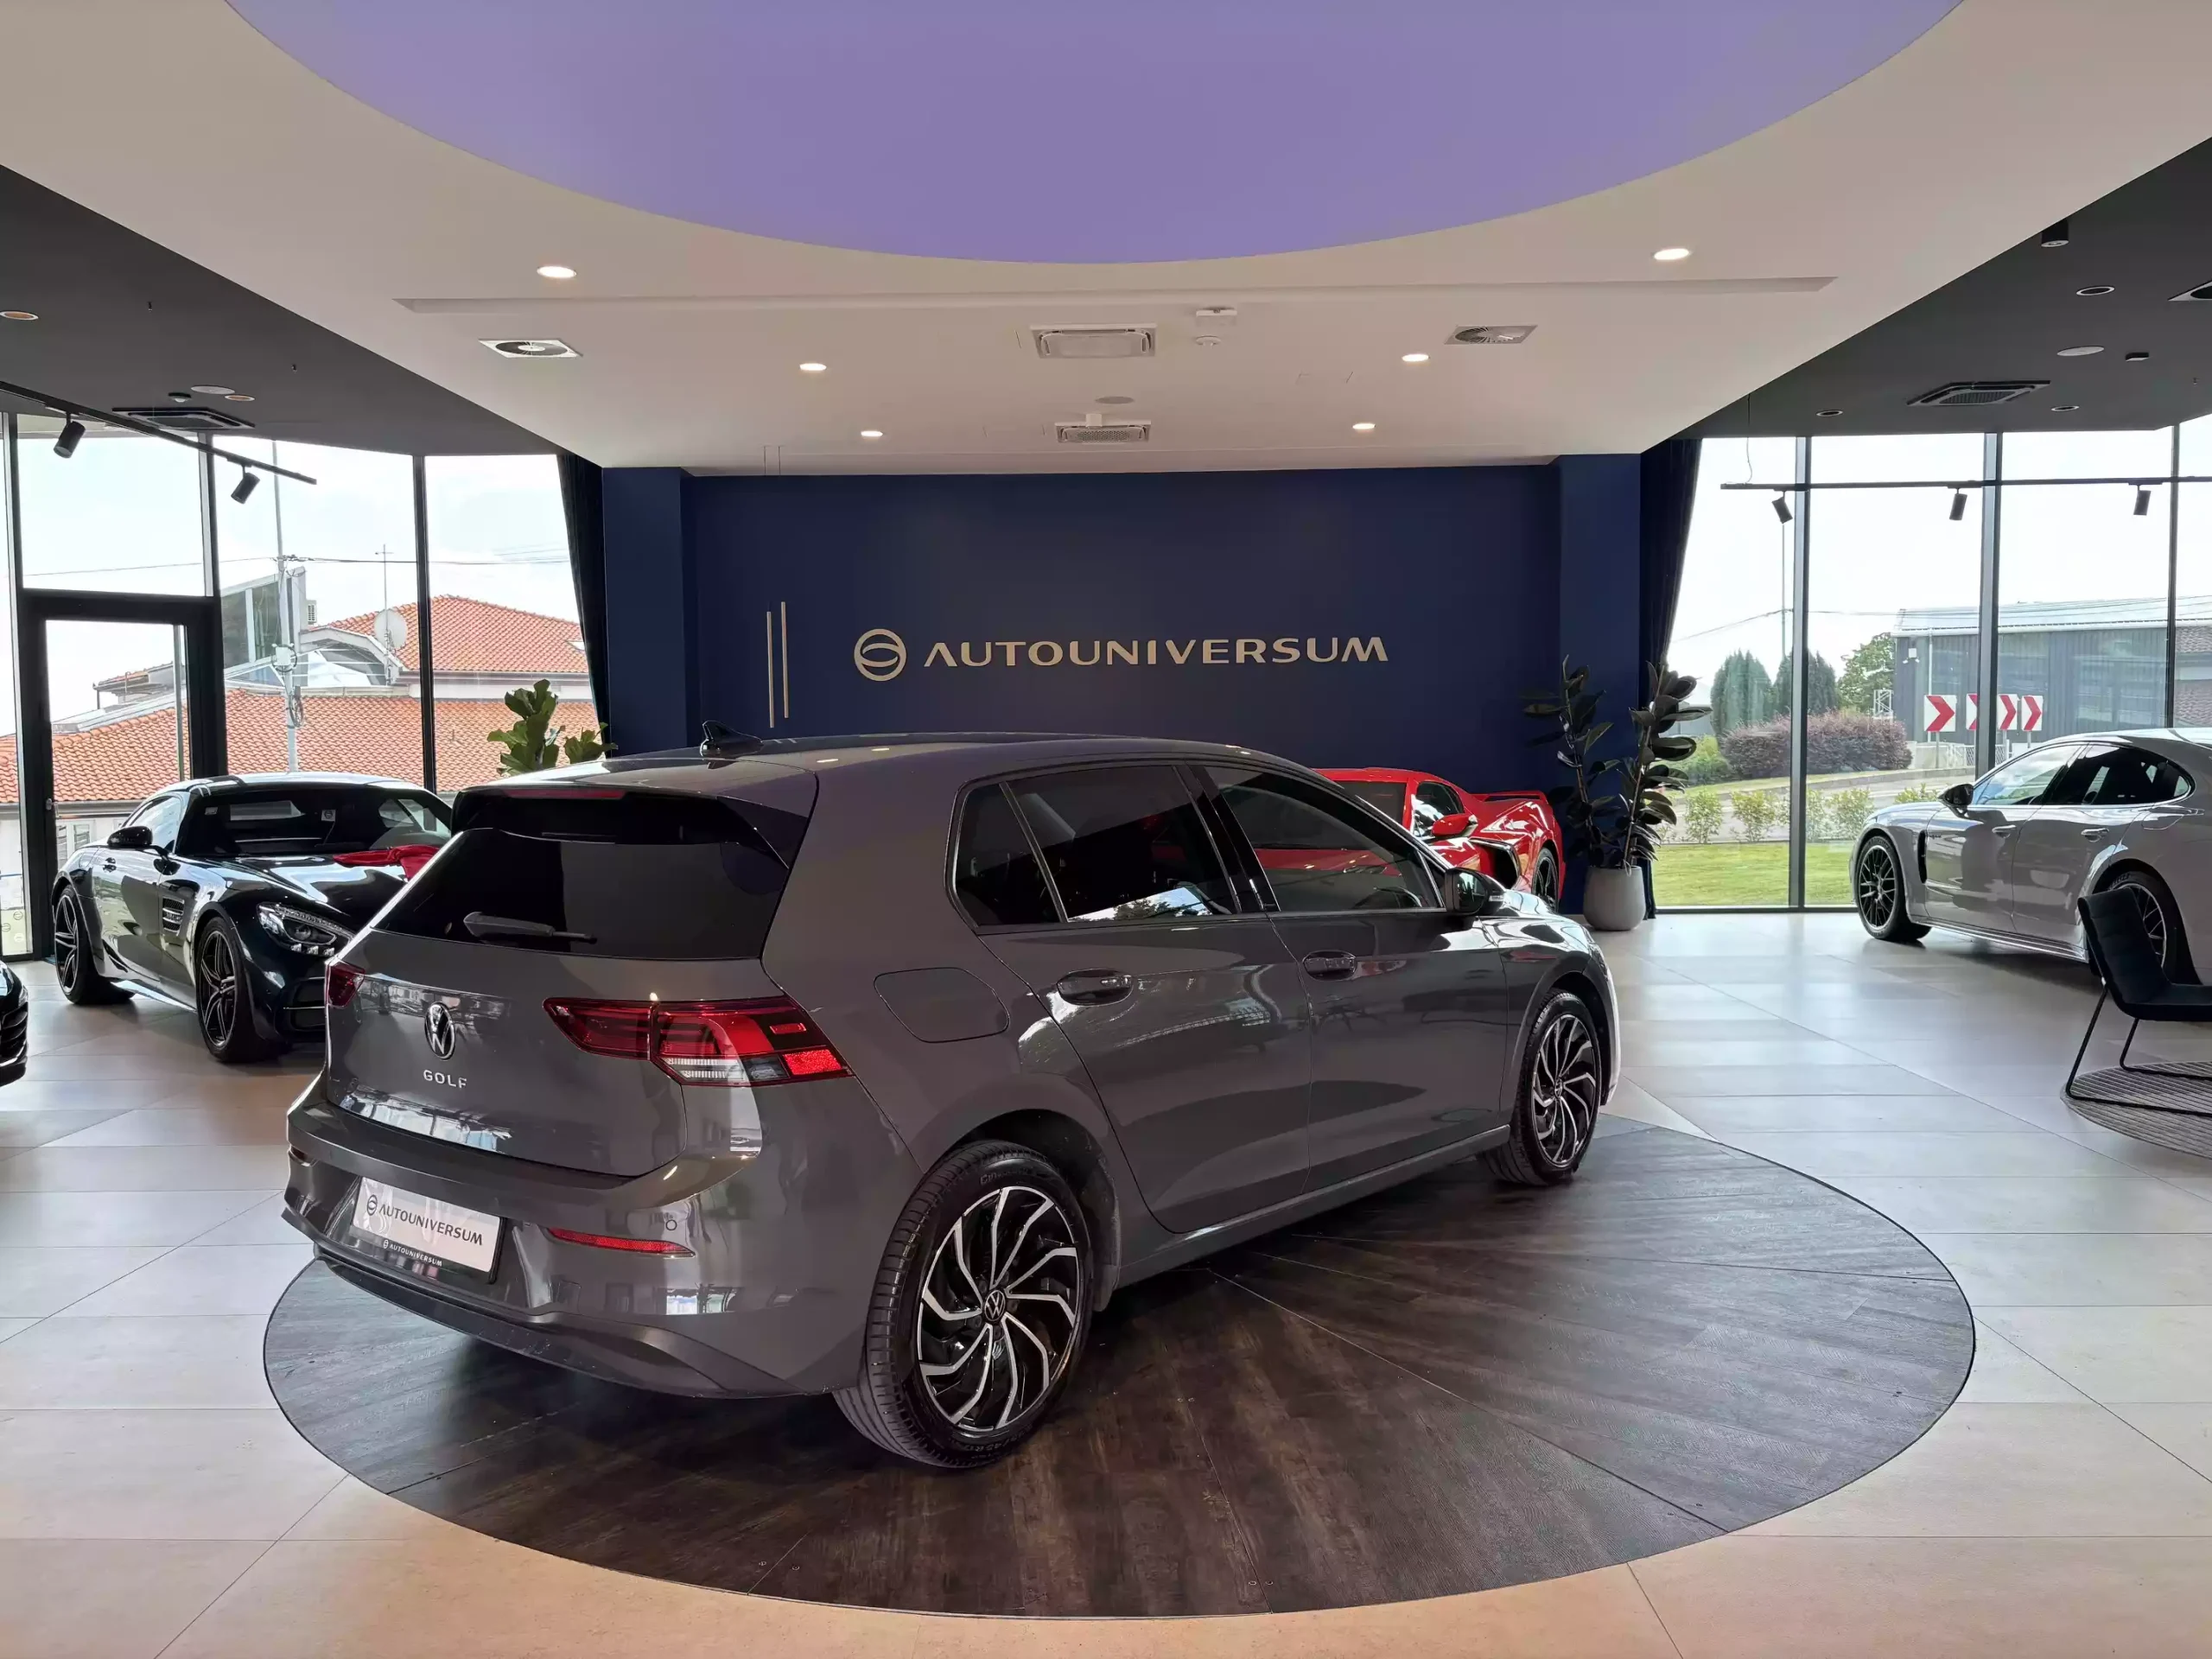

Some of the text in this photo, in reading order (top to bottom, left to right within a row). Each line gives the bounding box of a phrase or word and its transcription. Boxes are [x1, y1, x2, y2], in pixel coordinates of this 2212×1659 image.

[924, 637, 1389, 666] AUTOUNIVERSUM
[423, 1069, 467, 1089] GOLF
[378, 1206, 483, 1246] AUTOUNIVERSUM
[389, 1243, 442, 1267] AUTOUNIVERSUM
